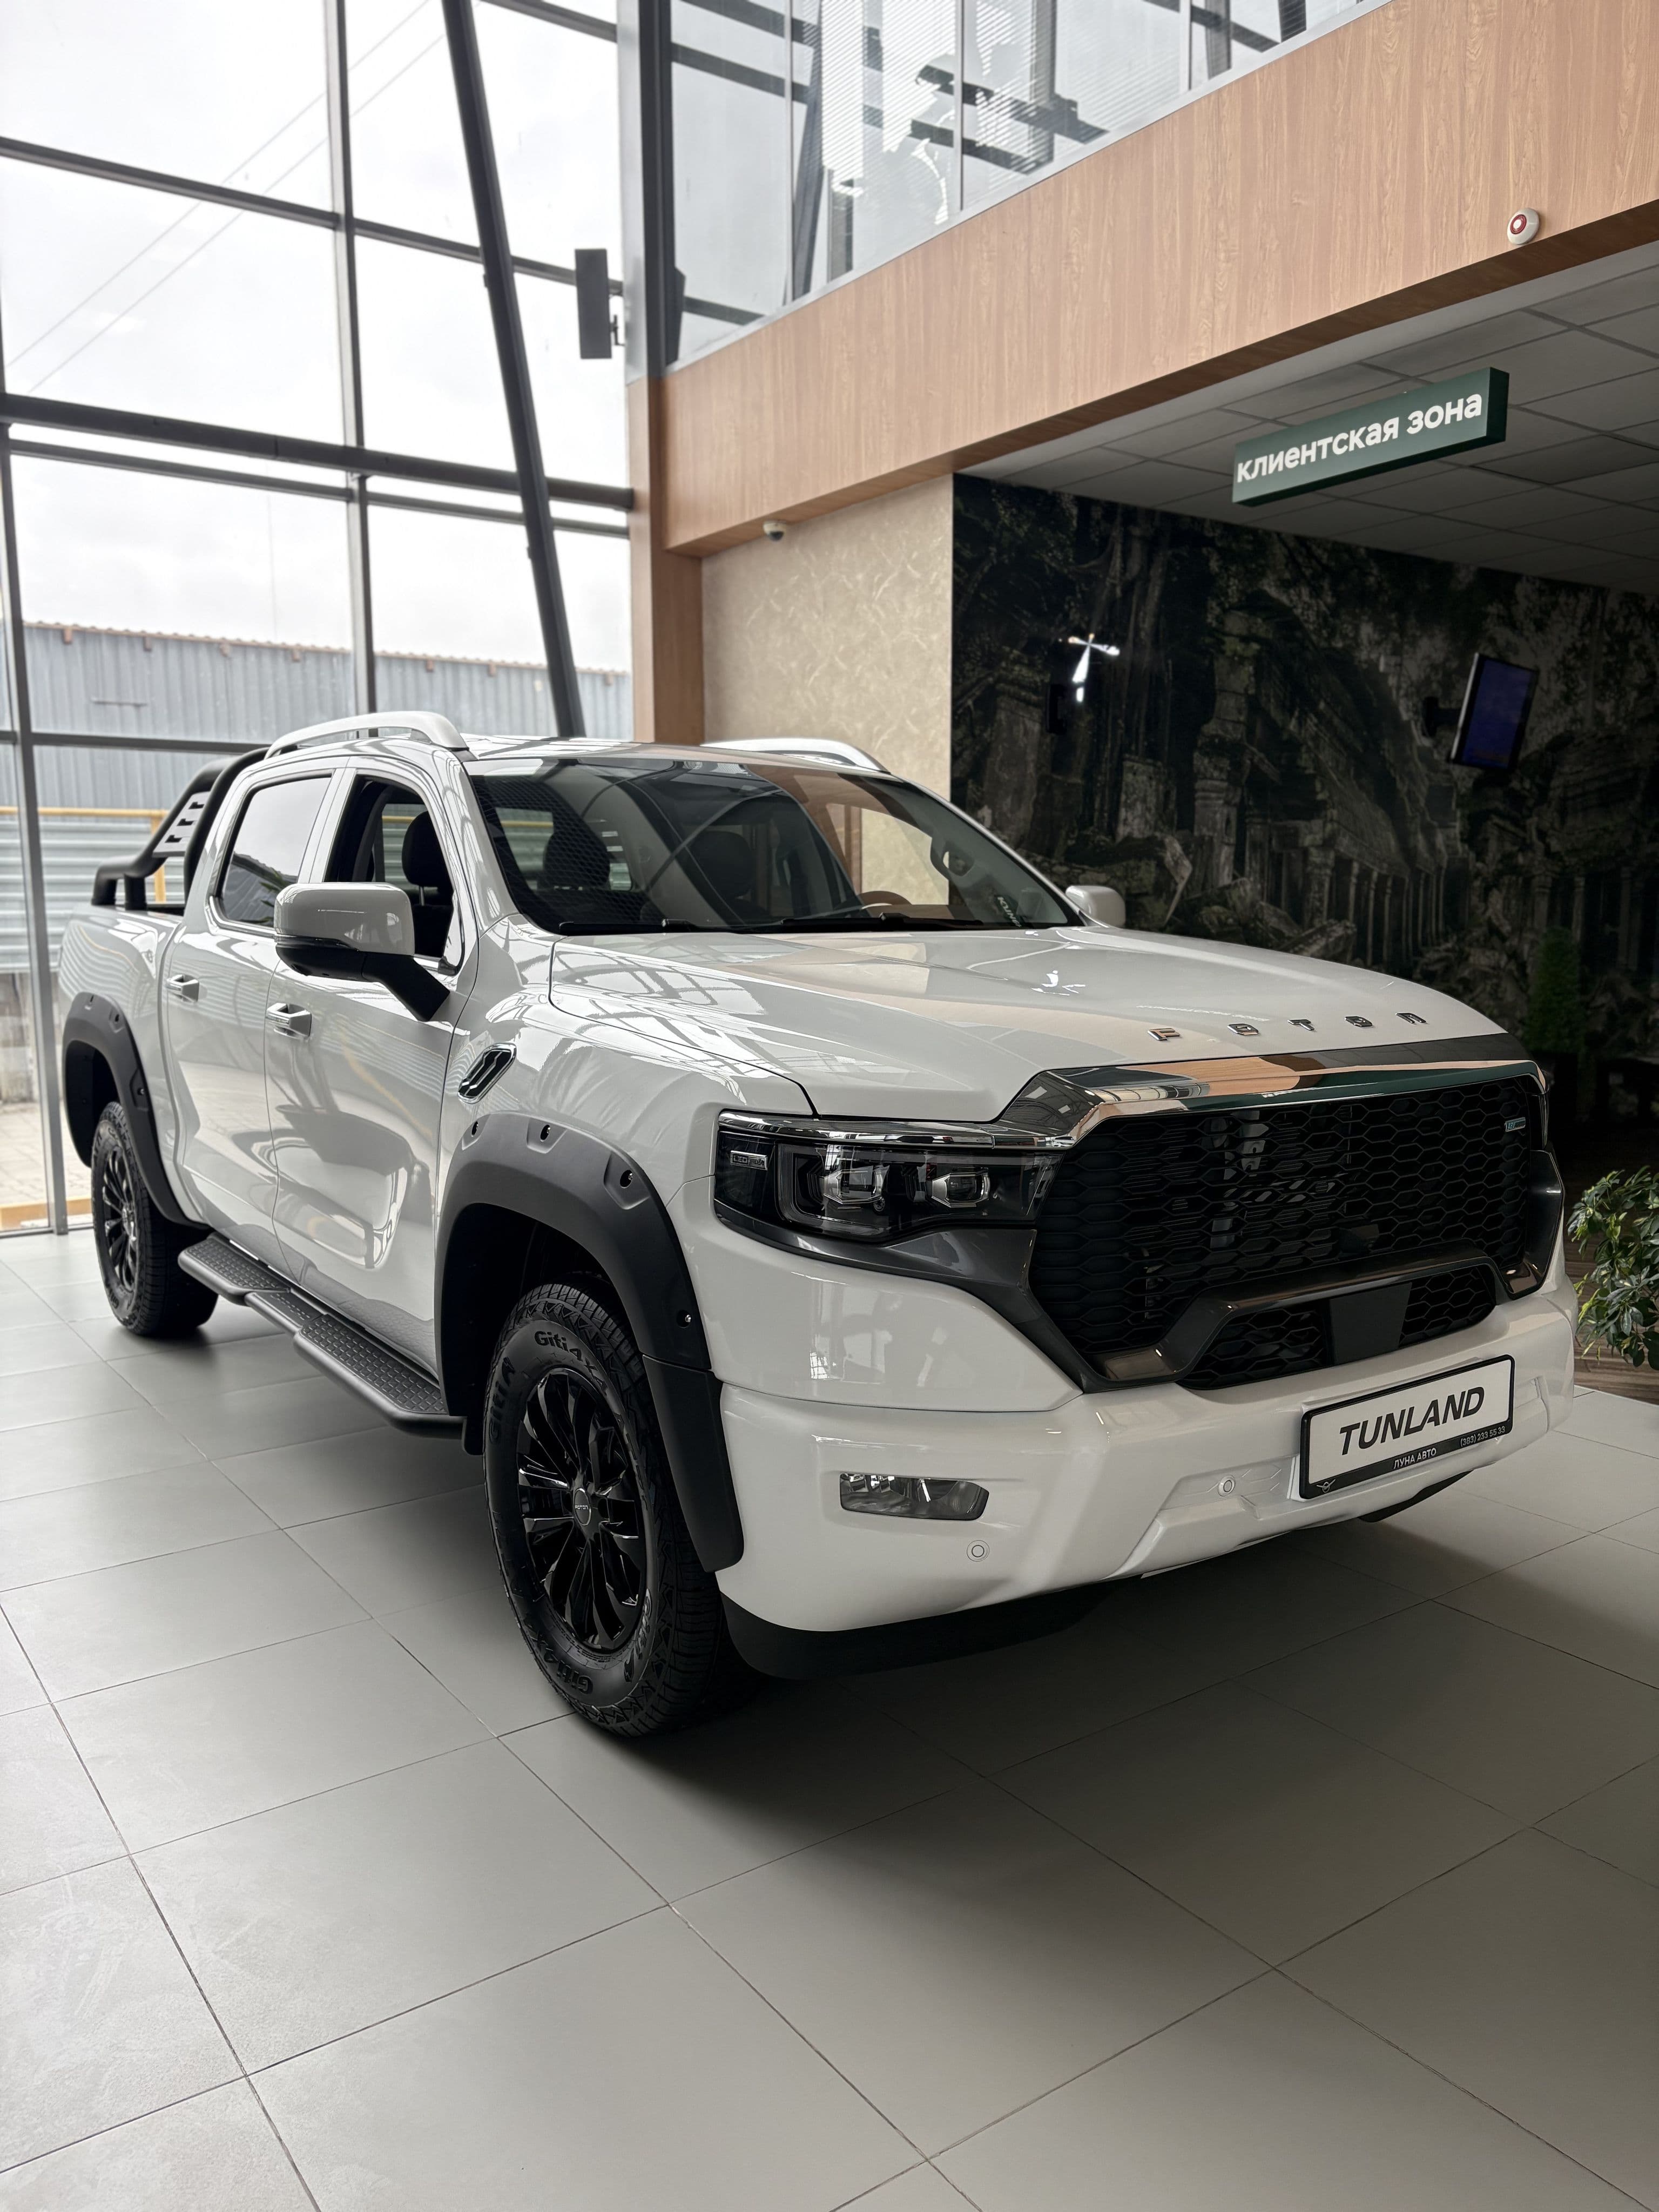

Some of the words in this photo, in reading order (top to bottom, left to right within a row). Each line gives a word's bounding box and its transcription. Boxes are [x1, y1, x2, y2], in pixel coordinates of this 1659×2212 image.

[1237, 416, 1399, 482] клиентская
[1406, 393, 1482, 434] зона
[1147, 1012, 1427, 1041] FOTON
[733, 1155, 747, 1163] LED
[1339, 1387, 1485, 1455] TUNLAND
[1460, 1434, 1476, 1447] (383)
[1478, 1431, 1488, 1441] 233
[1489, 1429, 1497, 1437] 55
[1498, 1426, 1506, 1434] 33
[1393, 1455, 1415, 1469] ЛУНА
[1417, 1447, 1437, 1462] АВТО
